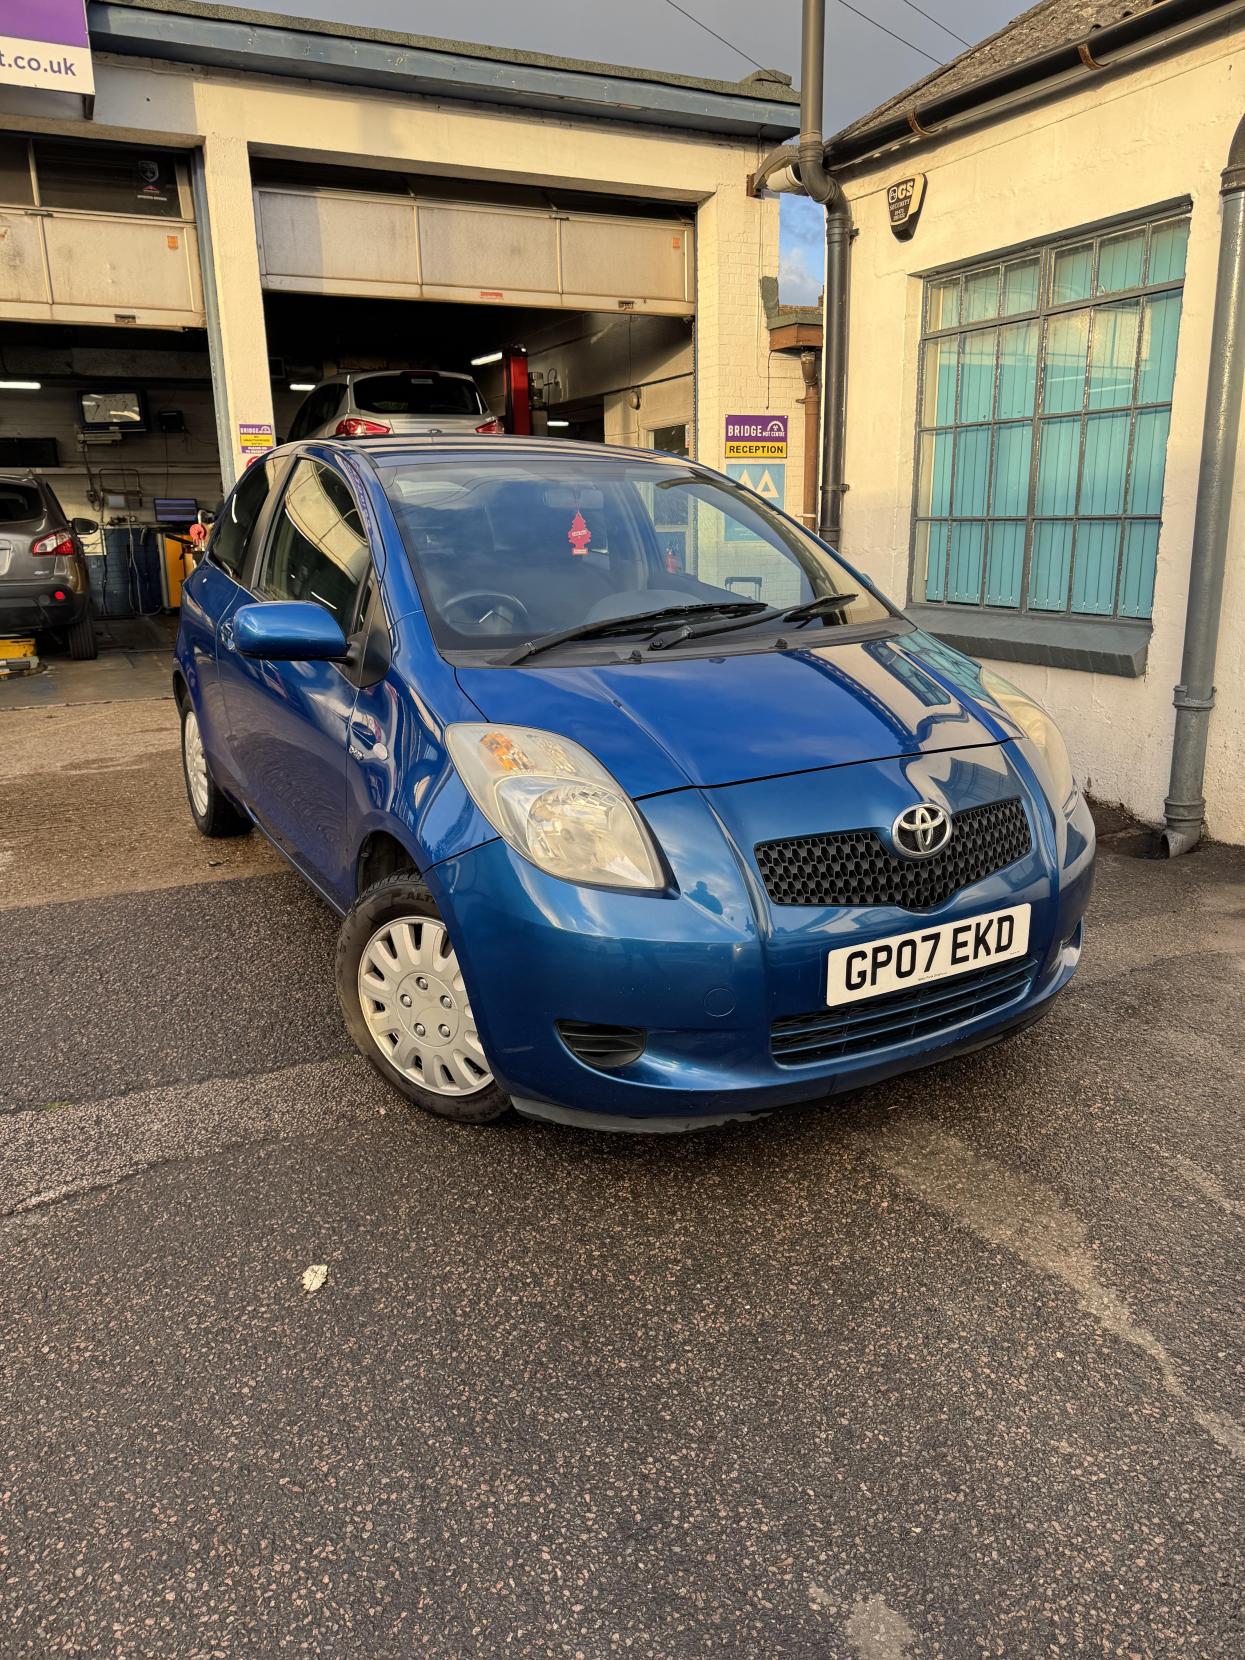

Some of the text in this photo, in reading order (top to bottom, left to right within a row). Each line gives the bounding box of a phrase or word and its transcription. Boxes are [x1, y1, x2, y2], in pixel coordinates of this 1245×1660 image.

[727, 425, 762, 437] BRIDGE
[729, 445, 784, 454] RECEPTION
[845, 914, 1014, 991] GP07 EKD
